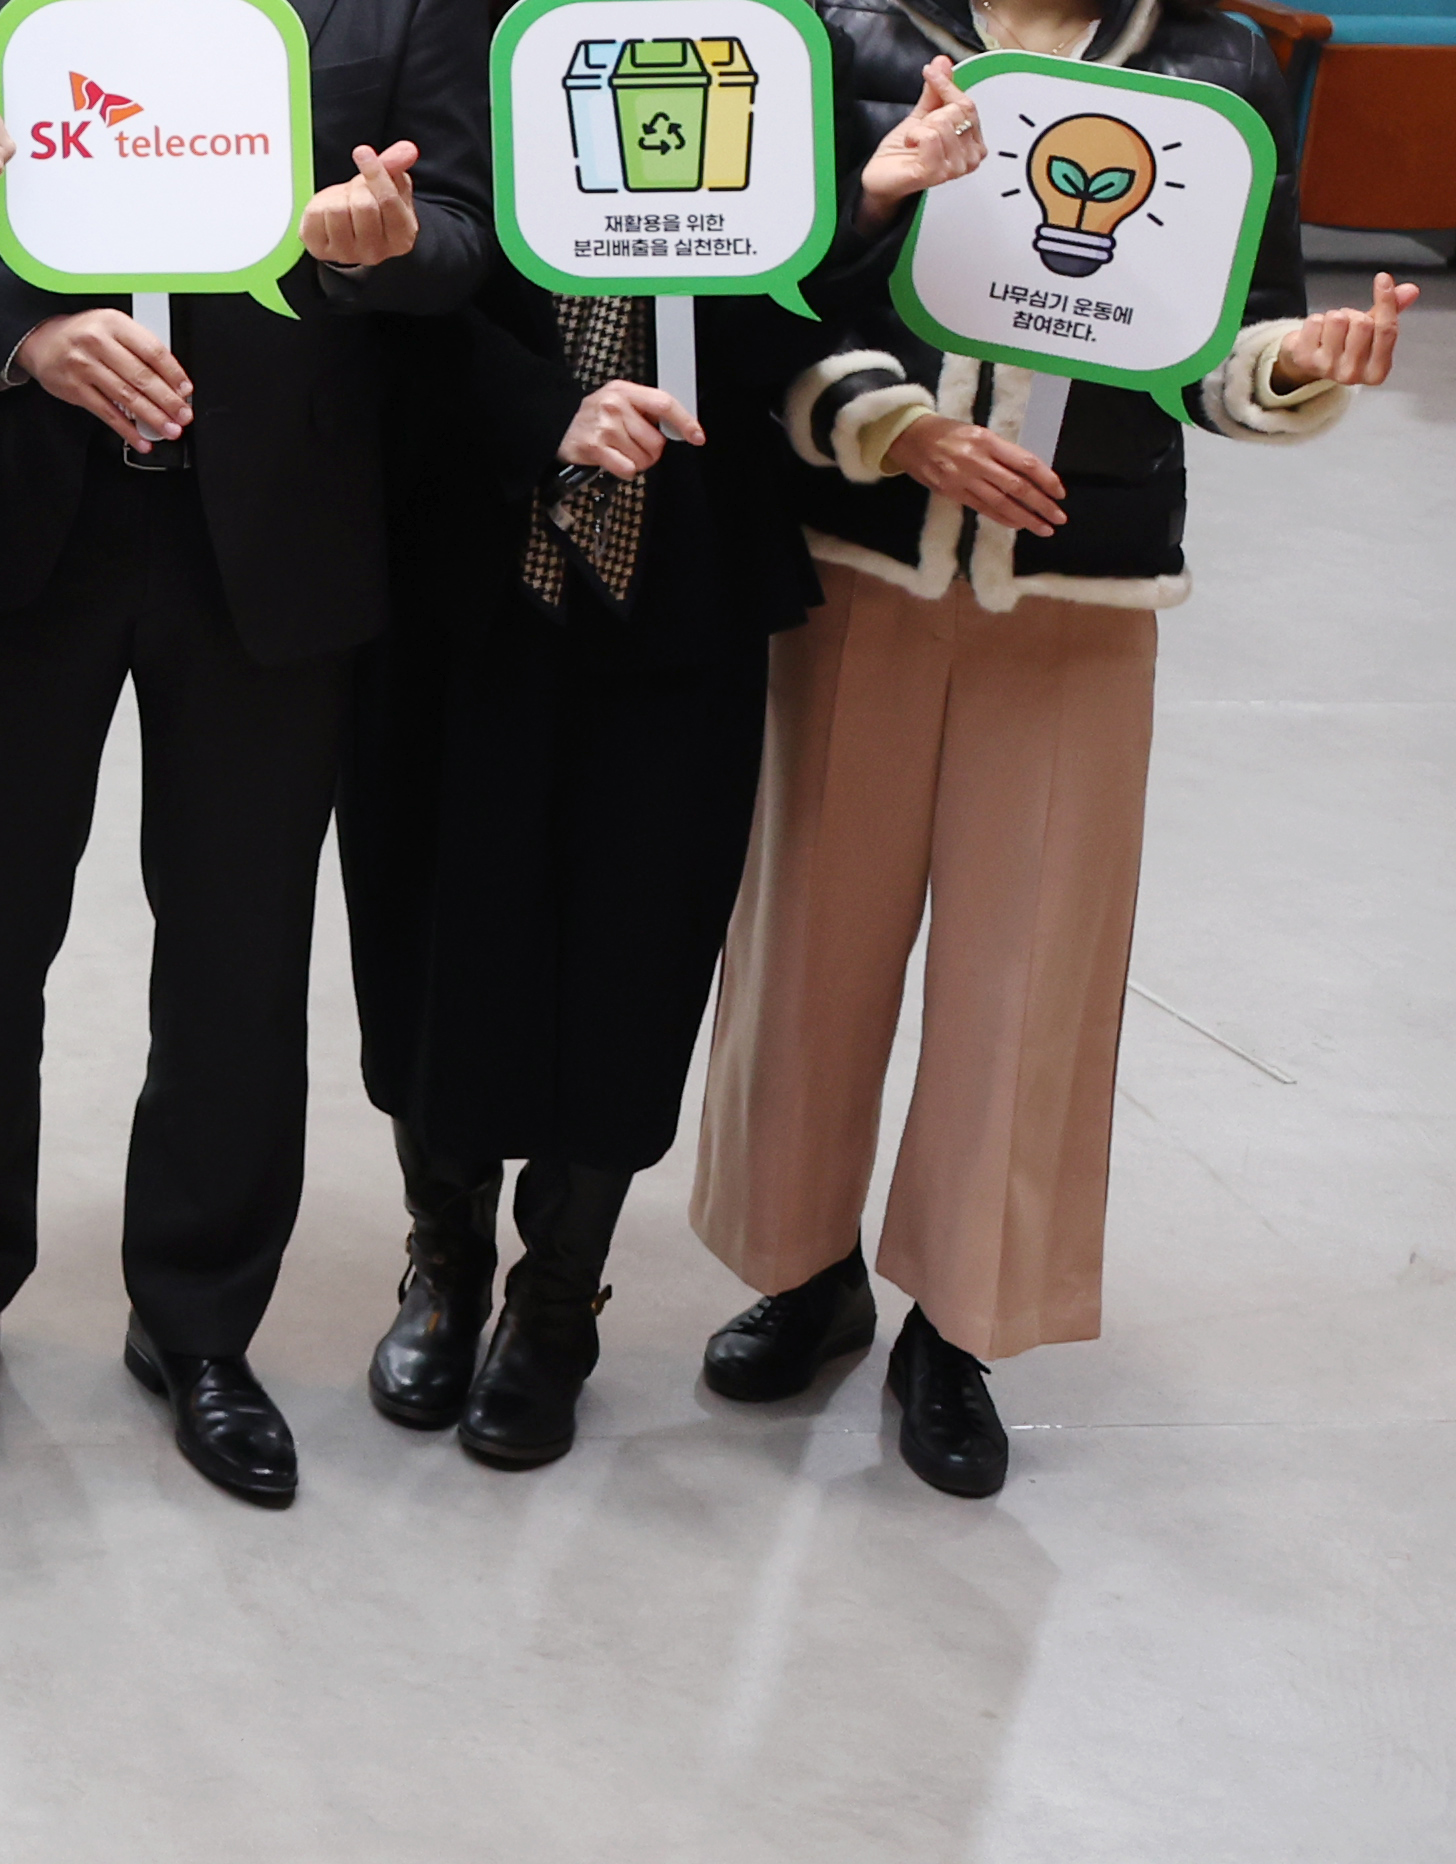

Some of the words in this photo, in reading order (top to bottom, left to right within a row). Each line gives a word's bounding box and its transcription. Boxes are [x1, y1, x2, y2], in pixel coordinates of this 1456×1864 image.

[30, 121, 94, 160] SK
[114, 125, 270, 158] telecom
[604, 213, 681, 233] 재활용을
[686, 213, 725, 233] 위한
[574, 238, 669, 258] 분리배출을
[674, 237, 758, 257] 실천한다.
[988, 281, 1070, 313] 나무심기
[1072, 296, 1134, 326] 운동에
[1012, 310, 1097, 343] 참여한다.
